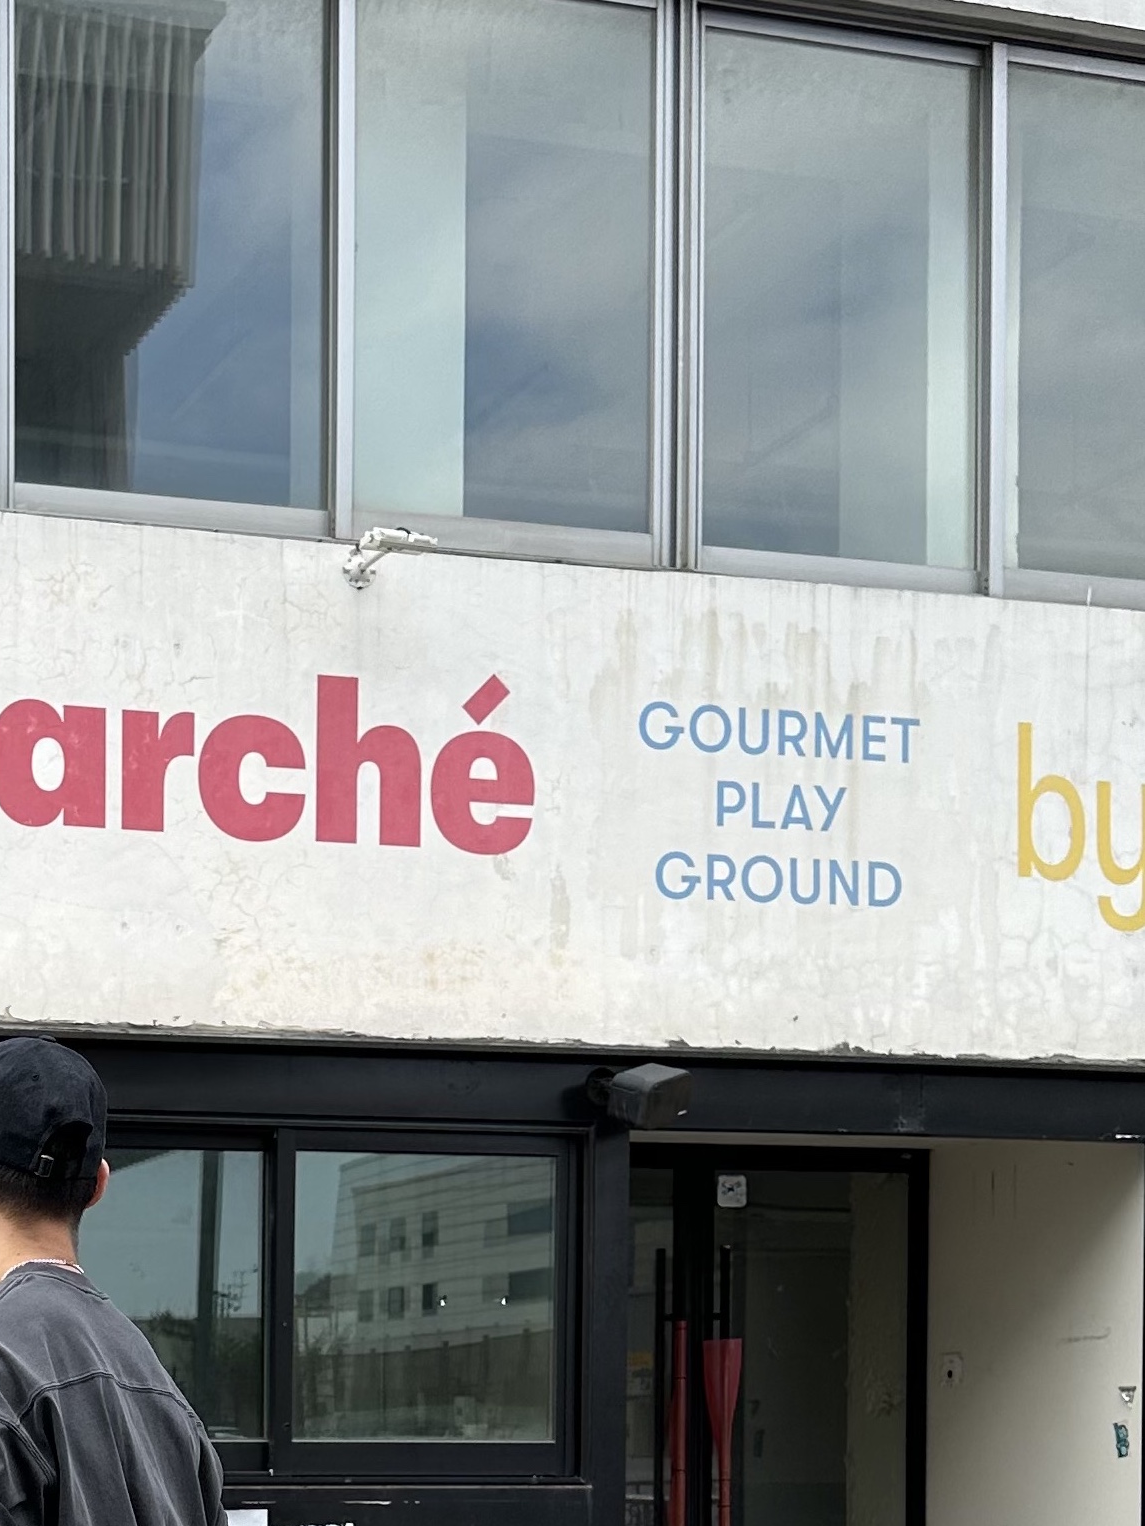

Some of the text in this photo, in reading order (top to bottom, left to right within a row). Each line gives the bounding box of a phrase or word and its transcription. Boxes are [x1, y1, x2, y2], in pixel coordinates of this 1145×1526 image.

[639, 701, 921, 763] GOURMET
[716, 780, 847, 831] PLAY
[1017, 722, 1145, 932] by
[655, 851, 902, 907] GROUND
